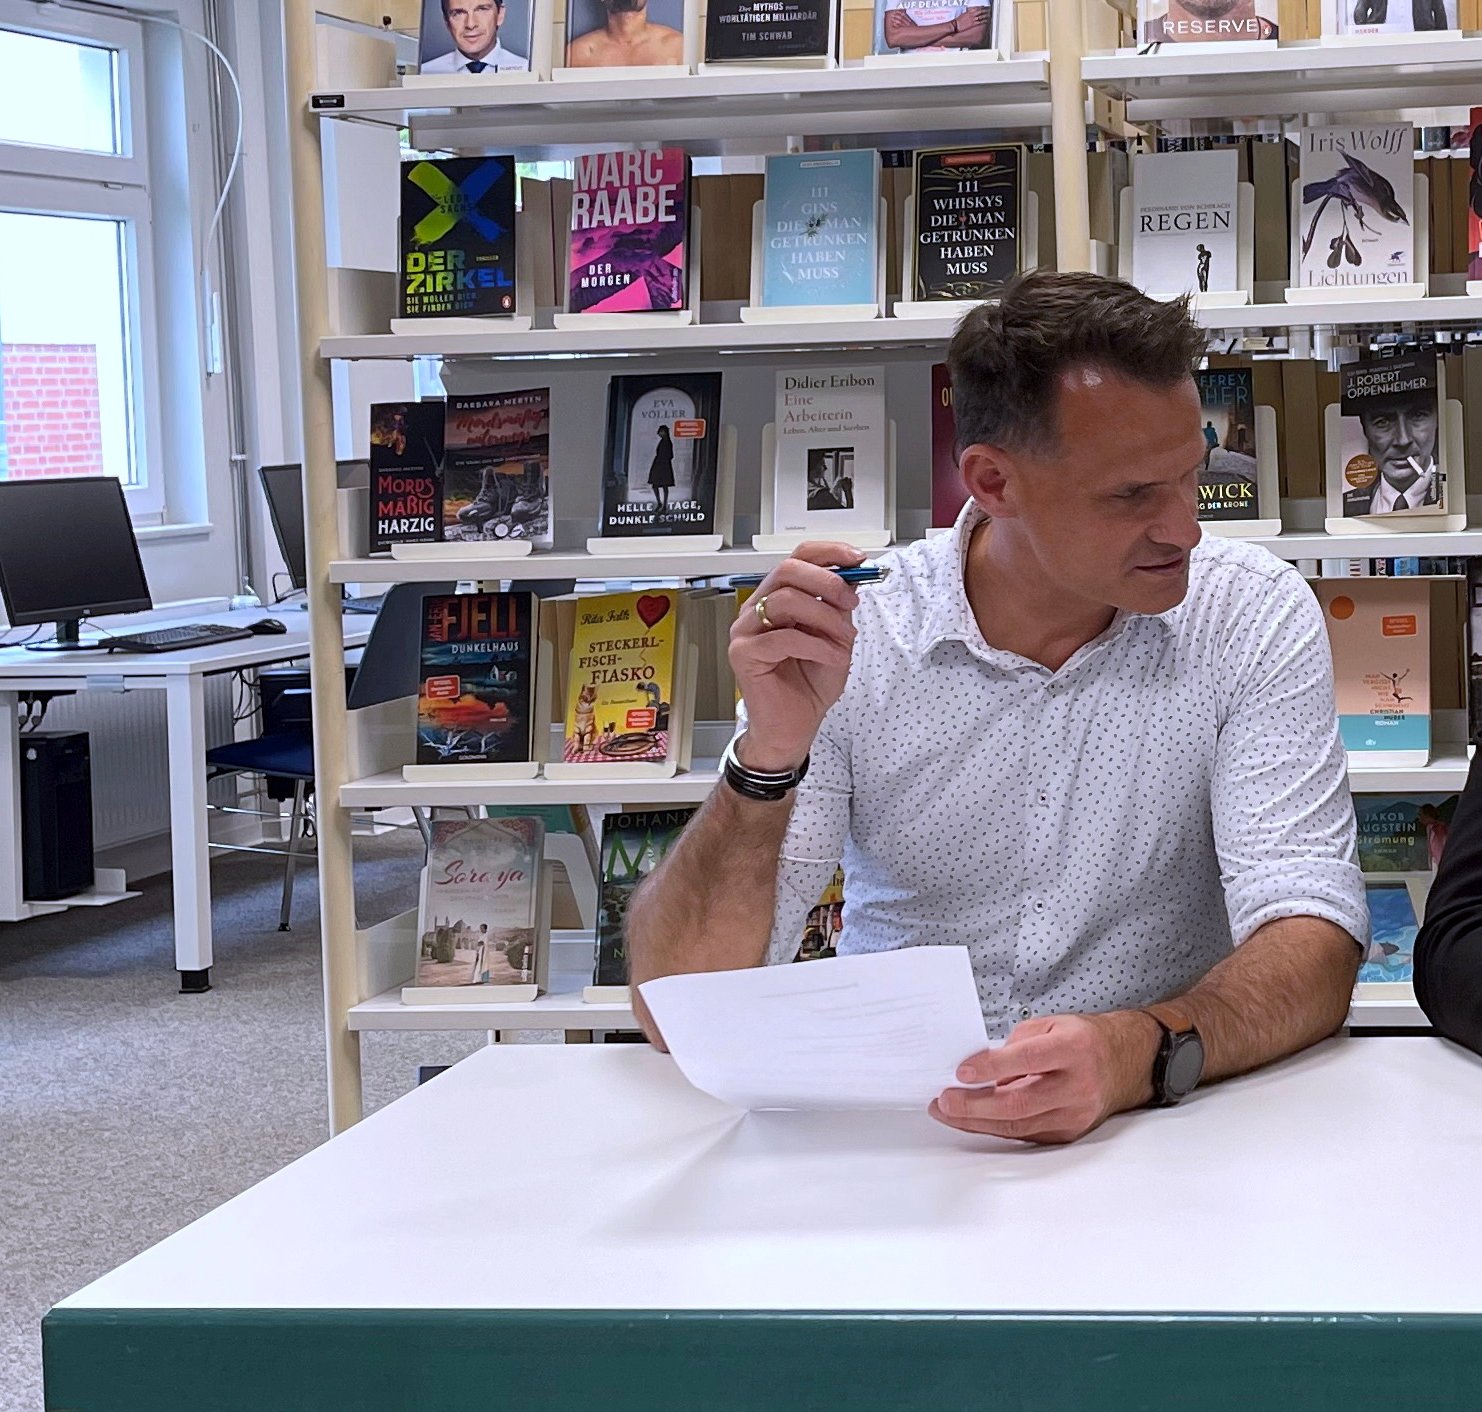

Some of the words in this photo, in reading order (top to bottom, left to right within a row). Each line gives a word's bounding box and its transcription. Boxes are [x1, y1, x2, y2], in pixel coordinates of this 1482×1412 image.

[753, 2, 784, 12] MYTHOS
[918, 0, 939, 9] DEM
[1163, 19, 1259, 35] RESERVE
[742, 32, 757, 42] TIM
[759, 31, 793, 41] SCHWAB
[1310, 131, 1346, 153] Iris
[1350, 127, 1408, 155] Wolff
[573, 148, 664, 193] MARC
[811, 186, 828, 198] 111
[957, 180, 979, 194] 111
[571, 184, 677, 232] RAABE
[801, 202, 838, 215] GINS
[933, 195, 1003, 211] WHISKYS
[776, 220, 802, 233] DIE
[827, 217, 862, 230] MAN
[930, 213, 957, 228] DIE
[968, 211, 1006, 225] MAN
[1139, 210, 1231, 233] REGEN
[770, 232, 868, 249] GETRUNKEN
[919, 227, 1016, 244] GETRUNKEN
[791, 250, 847, 265] HABEN
[940, 244, 995, 260] HABEN
[406, 250, 465, 273] DER
[946, 262, 988, 276] MUSS
[589, 263, 612, 276] DER
[798, 267, 840, 280] MUSS
[406, 266, 513, 294] ZIRKEL
[581, 273, 631, 289] MORGEN
[1308, 268, 1408, 287] Lichtungen
[406, 296, 419, 305] SIE
[406, 304, 419, 314] SIE
[784, 375, 827, 390] Didier
[830, 373, 875, 389] Eribon
[1347, 377, 1355, 389] J.
[1357, 370, 1401, 387] ROBERT
[1347, 376, 1428, 399] OPPENHEIMER
[456, 400, 501, 409] BARBARA
[653, 399, 675, 409] EVA
[784, 393, 815, 407] Eine
[641, 409, 686, 420] VÖLLER
[784, 408, 853, 423] Arbeiterin
[617, 502, 654, 513] HELLE
[668, 500, 701, 511] TAGE,
[1207, 501, 1222, 510] DER
[377, 517, 435, 535] HARZIG
[609, 515, 655, 526] DUNKLE
[659, 512, 705, 524] SCHULD
[442, 595, 521, 642] FJELL
[580, 613, 604, 625] Rita
[606, 609, 630, 622] Falk
[451, 641, 519, 654] DUNKELHAUS
[589, 636, 665, 653] STECKERL-
[578, 653, 622, 668] FISCH-
[590, 665, 656, 685] FIASKO
[1365, 812, 1405, 822] JAKOB
